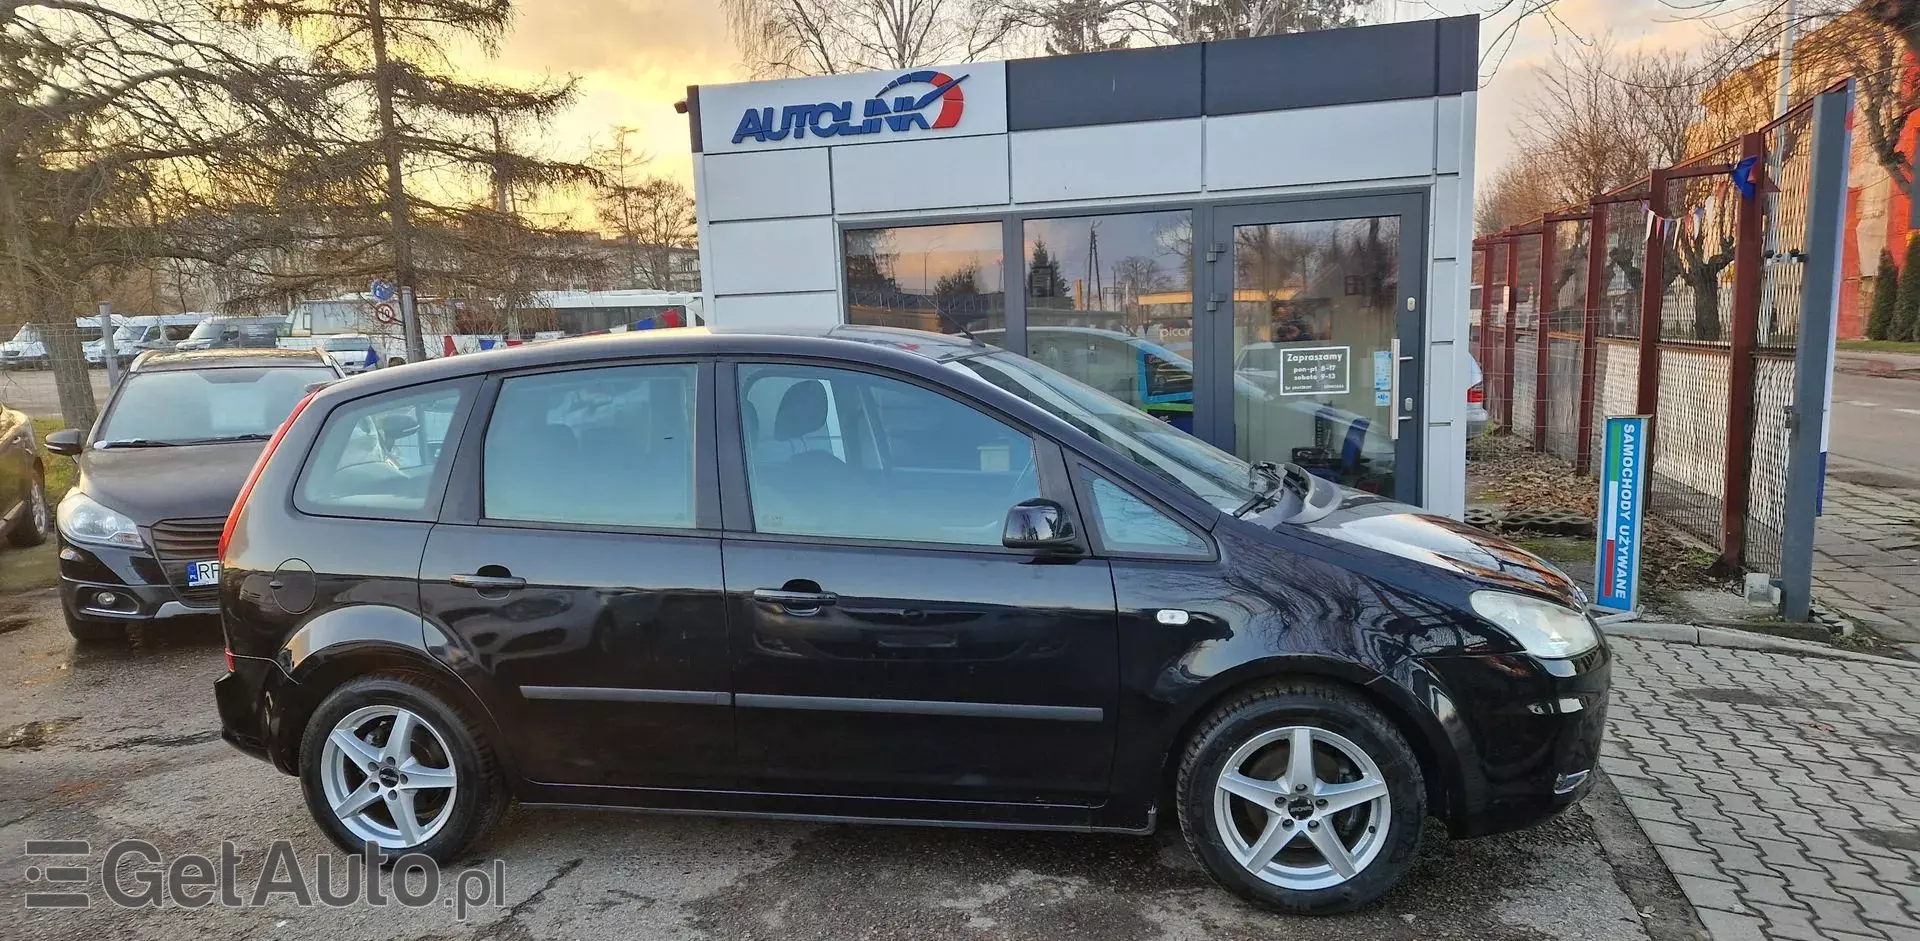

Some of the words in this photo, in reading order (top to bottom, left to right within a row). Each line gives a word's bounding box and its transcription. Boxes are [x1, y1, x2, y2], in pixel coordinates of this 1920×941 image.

[731, 84, 952, 144] AUTOLINK
[1287, 354, 1342, 363] Zapraszamy
[1620, 424, 1635, 521] SAMOCHODY
[1616, 525, 1630, 599] UŻYWANE
